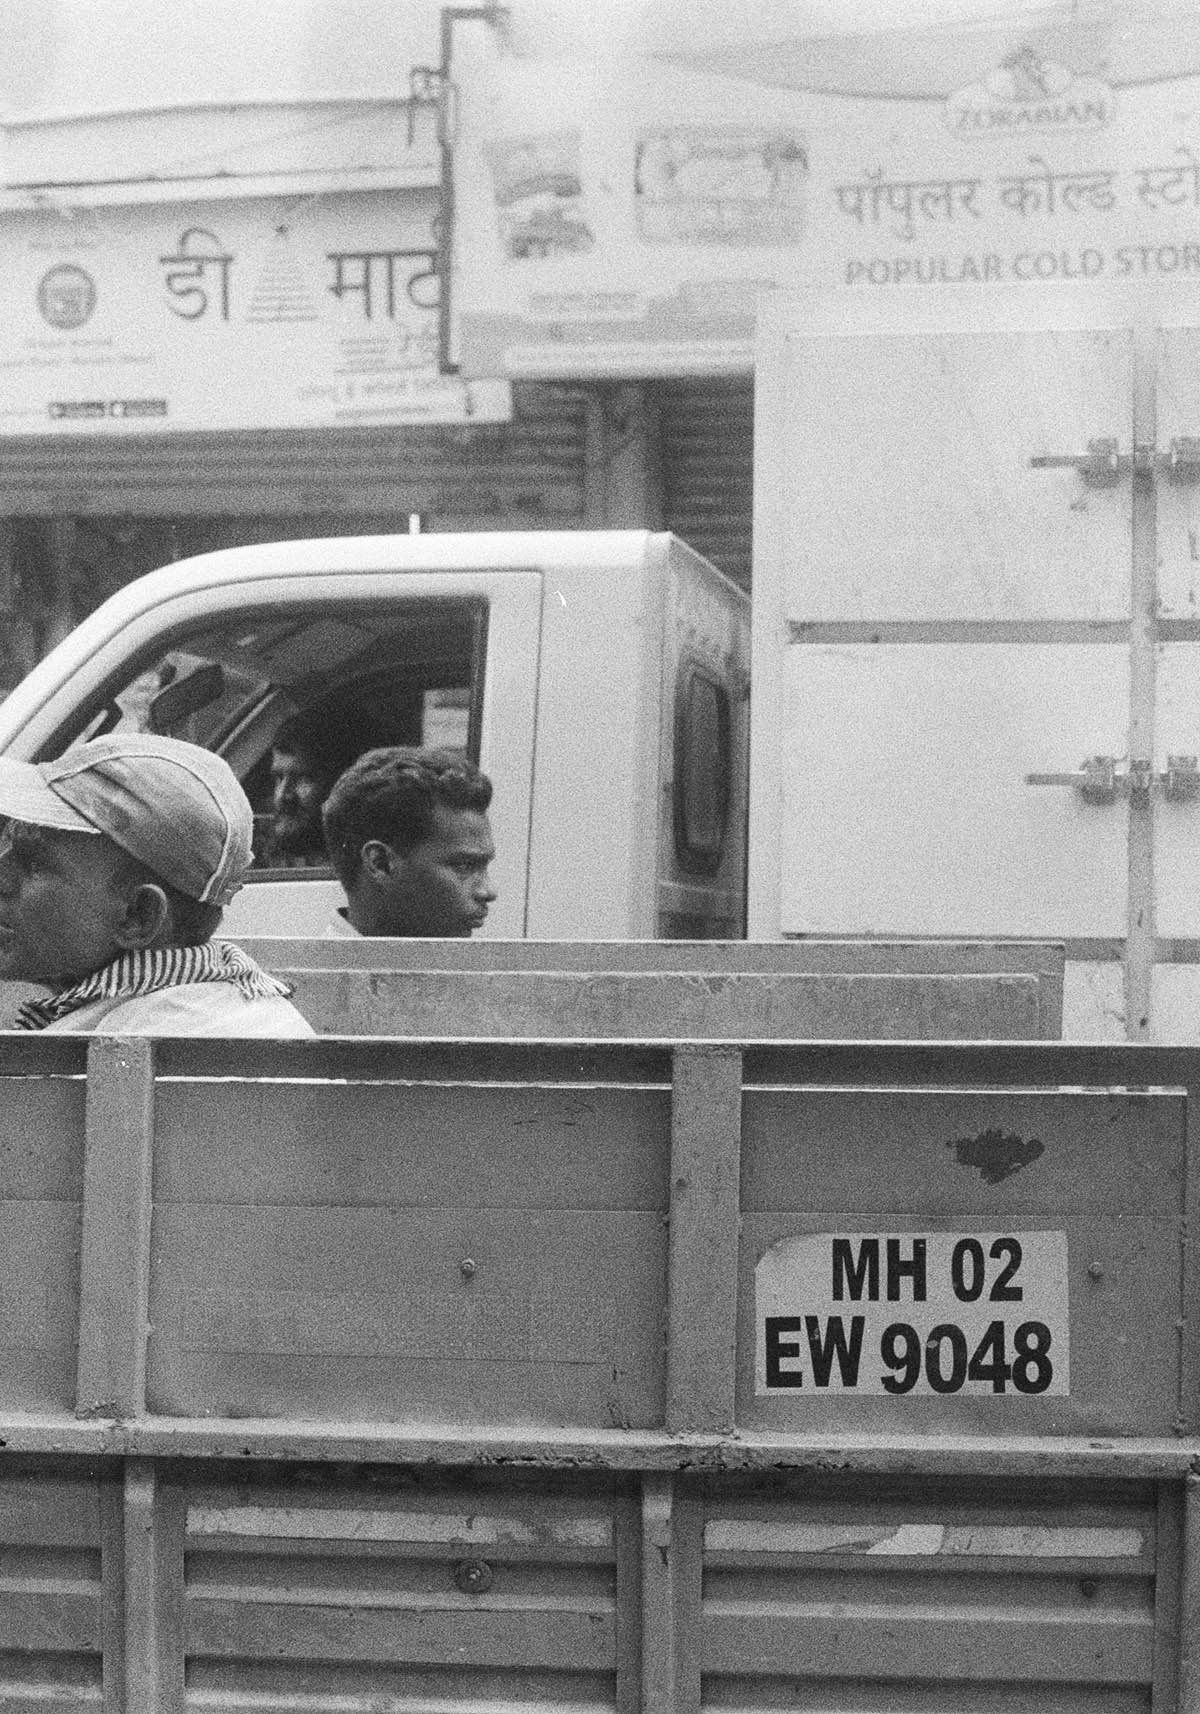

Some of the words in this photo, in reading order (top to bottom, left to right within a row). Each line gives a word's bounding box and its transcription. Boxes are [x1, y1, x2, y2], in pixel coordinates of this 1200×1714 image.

[955, 100, 1107, 131] ZORABIAN
[833, 165, 983, 241] पॉपुलर
[997, 154, 1118, 216] कोल्ड
[158, 226, 234, 321] डी
[844, 253, 1002, 285] POPULAR
[1012, 248, 1104, 280] COLD
[831, 1238, 927, 1302] MH
[951, 1237, 1023, 1303] 02
[764, 1315, 866, 1389] EW
[880, 1320, 1054, 1395] 9048
